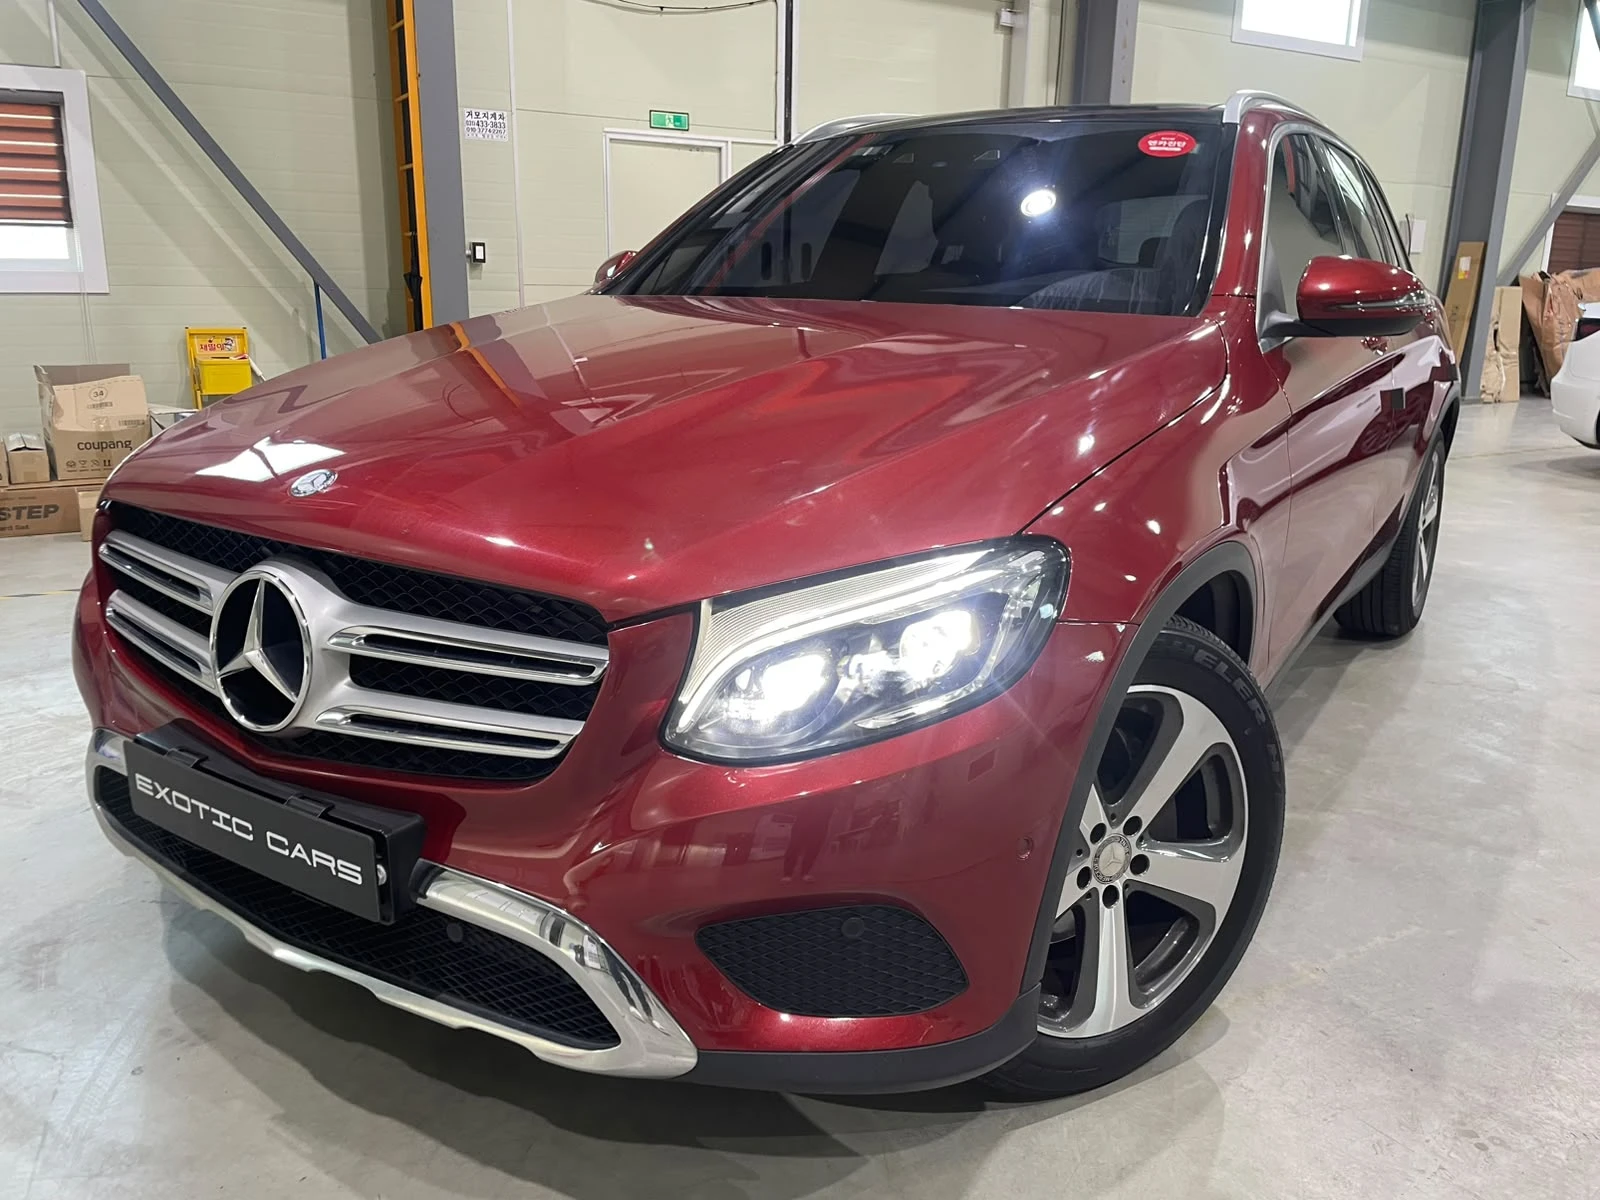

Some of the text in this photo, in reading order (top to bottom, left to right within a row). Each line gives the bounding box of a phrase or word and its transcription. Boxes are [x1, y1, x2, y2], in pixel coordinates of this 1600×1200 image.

[77, 440, 133, 453] coupang
[0, 504, 59, 521] STEP
[135, 773, 363, 885] EXOTIC CARS
